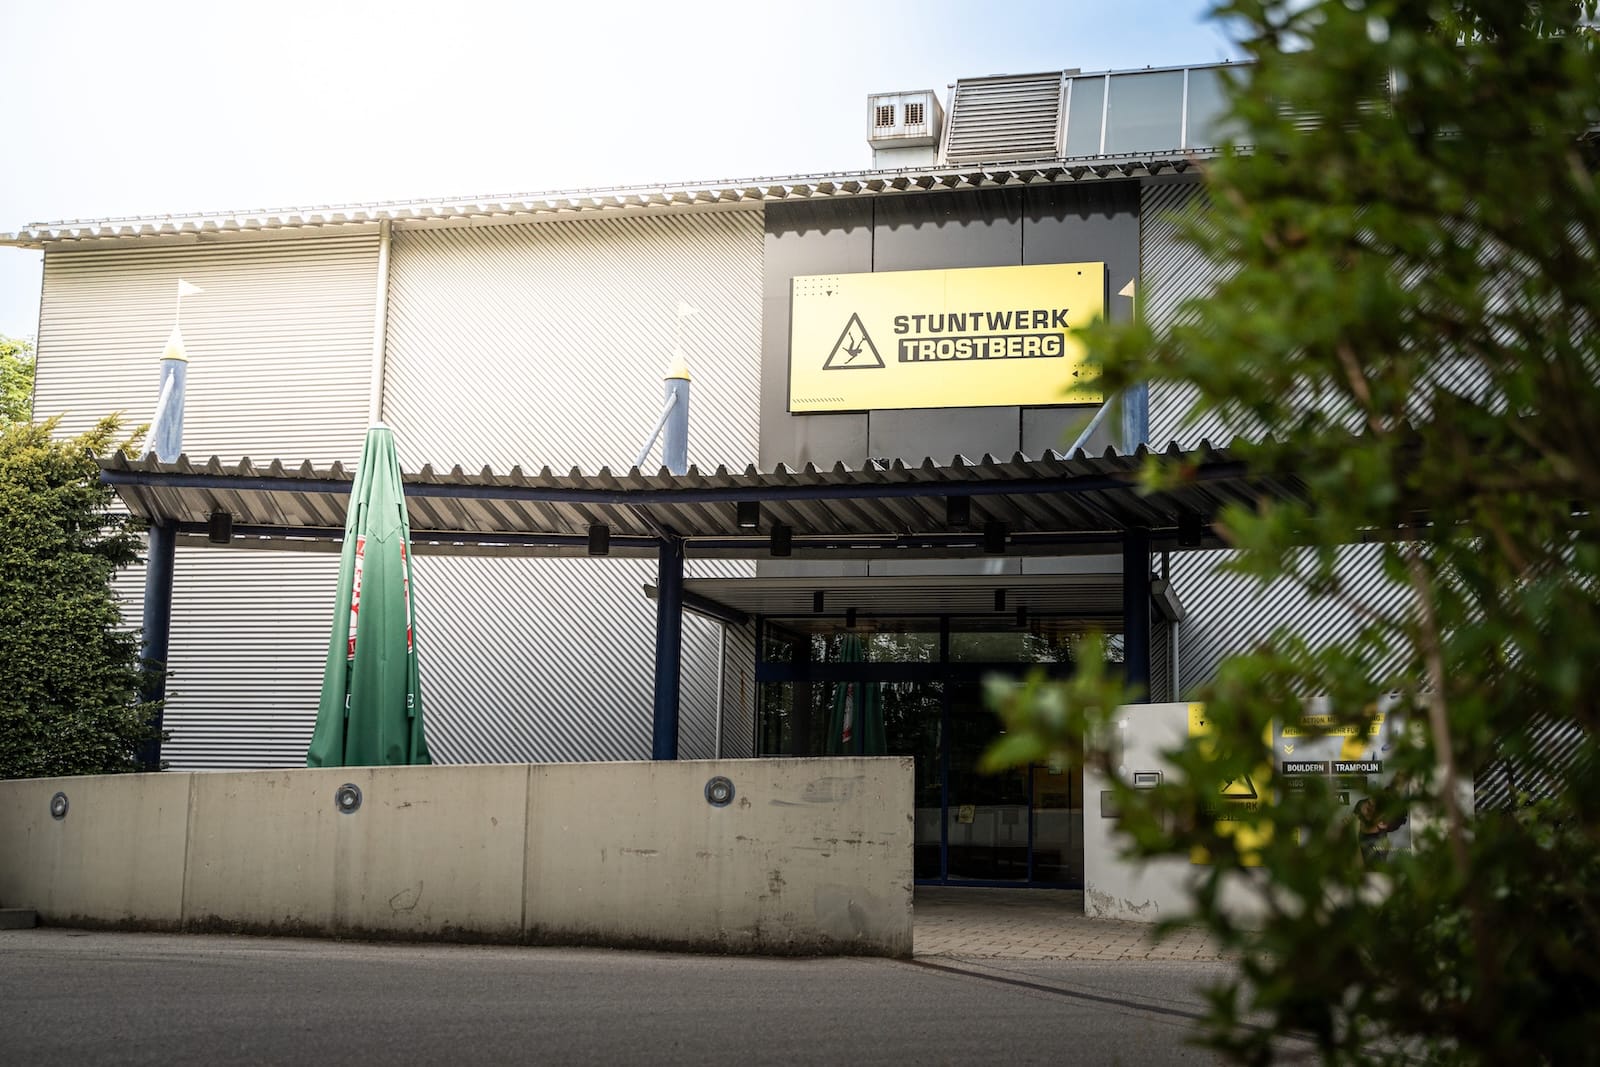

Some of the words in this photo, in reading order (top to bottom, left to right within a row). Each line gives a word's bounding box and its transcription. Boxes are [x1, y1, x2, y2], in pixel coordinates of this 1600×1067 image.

[894, 309, 1069, 334] STUNTWERK
[902, 335, 1061, 361] TROSTBERG
[1287, 764, 1324, 772] BOULDERN
[1335, 763, 1379, 772] TRAMPOLIN
